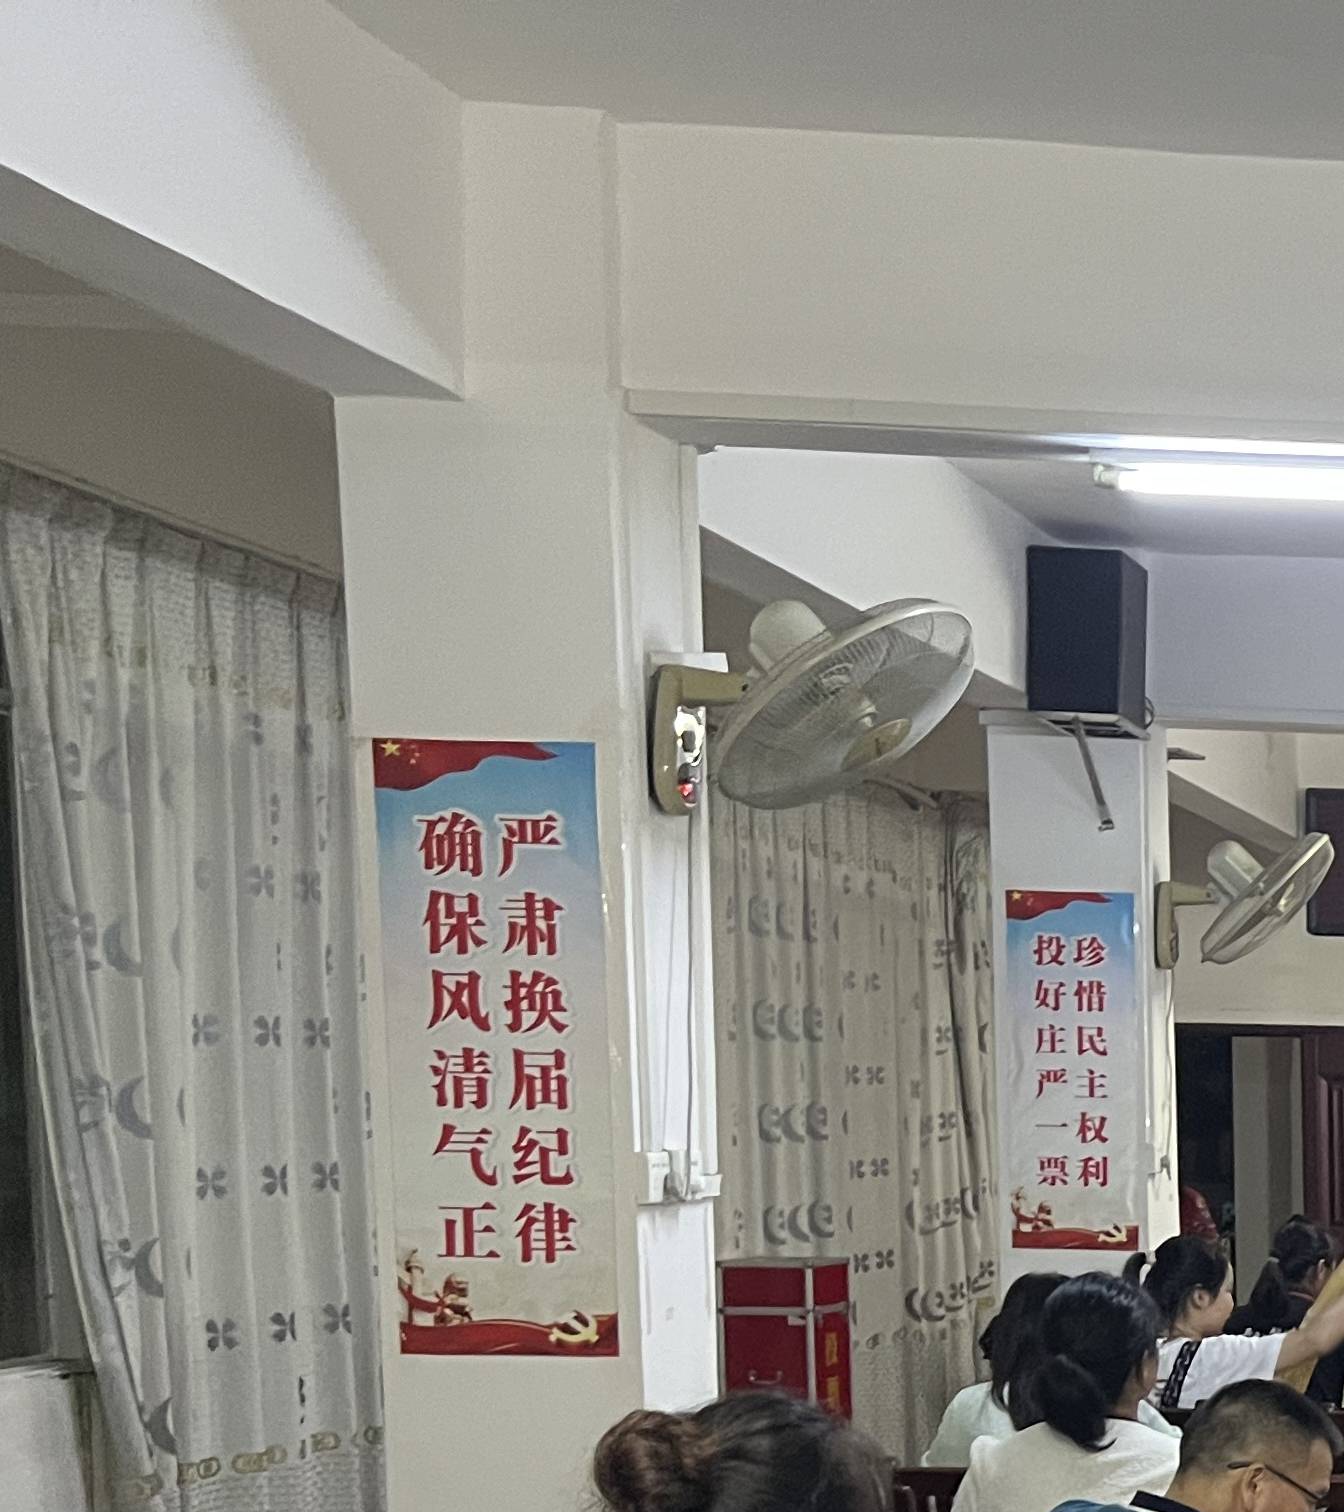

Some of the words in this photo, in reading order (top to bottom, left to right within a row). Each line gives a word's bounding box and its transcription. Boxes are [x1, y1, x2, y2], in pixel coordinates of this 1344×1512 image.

[416, 811, 500, 1259] 确保风清气正
[499, 813, 577, 1263] 严肃换届纪律
[1033, 935, 1069, 1186] 投好庄严一票
[1072, 936, 1108, 1187] 珍惜民主权利
